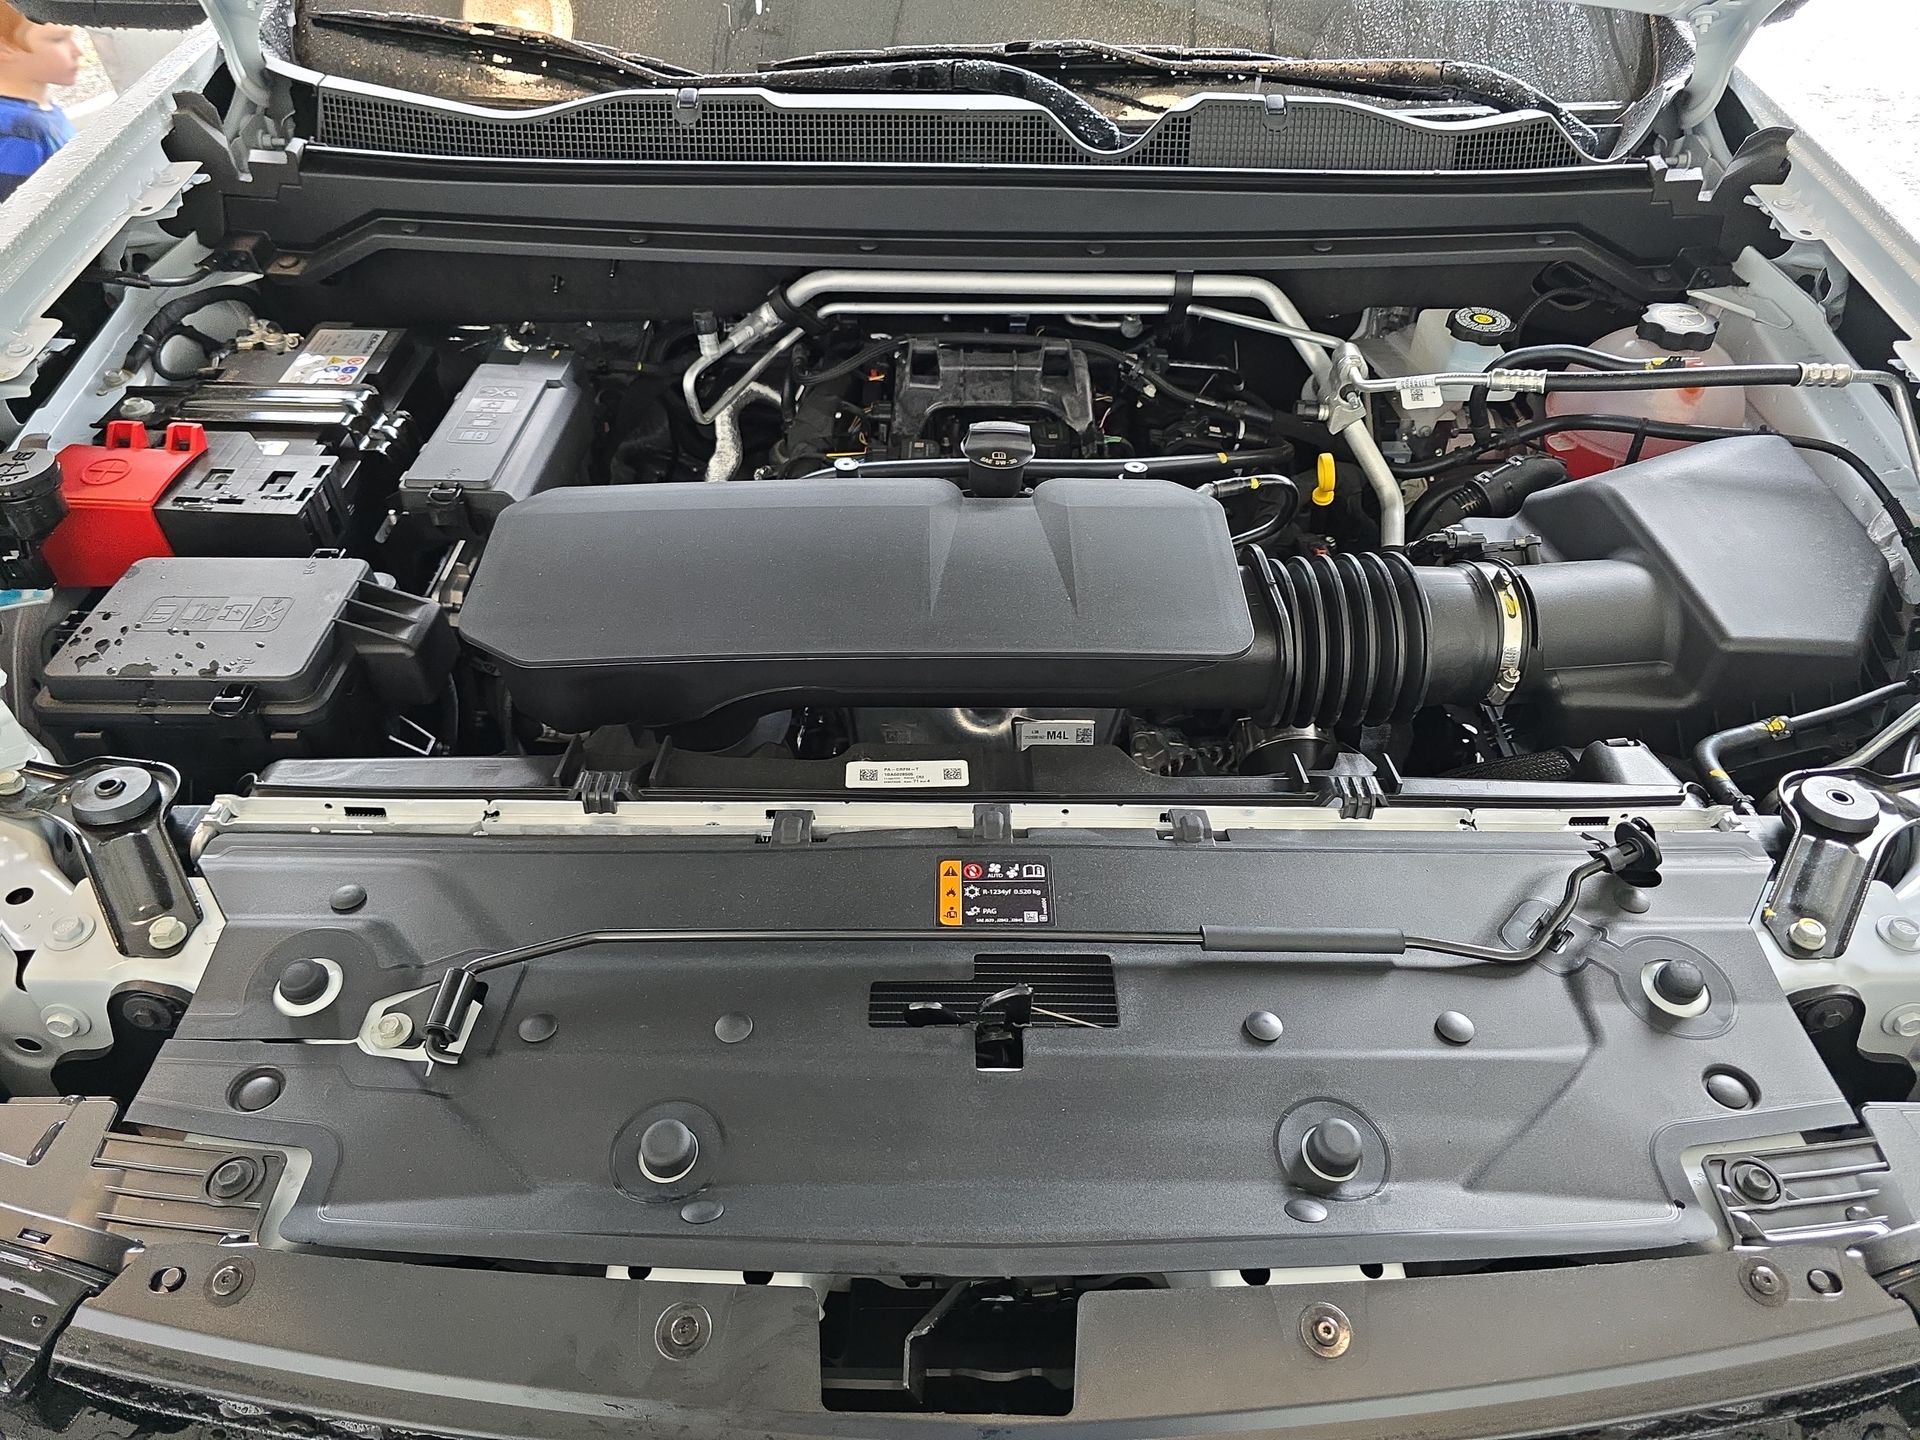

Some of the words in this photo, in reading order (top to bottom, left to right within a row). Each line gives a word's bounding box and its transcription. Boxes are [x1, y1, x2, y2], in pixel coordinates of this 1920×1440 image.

[979, 457, 993, 465] SAE
[1046, 730, 1069, 740] M4L
[982, 888, 1012, 896] R-1234yf
[1032, 888, 1041, 896] kg
